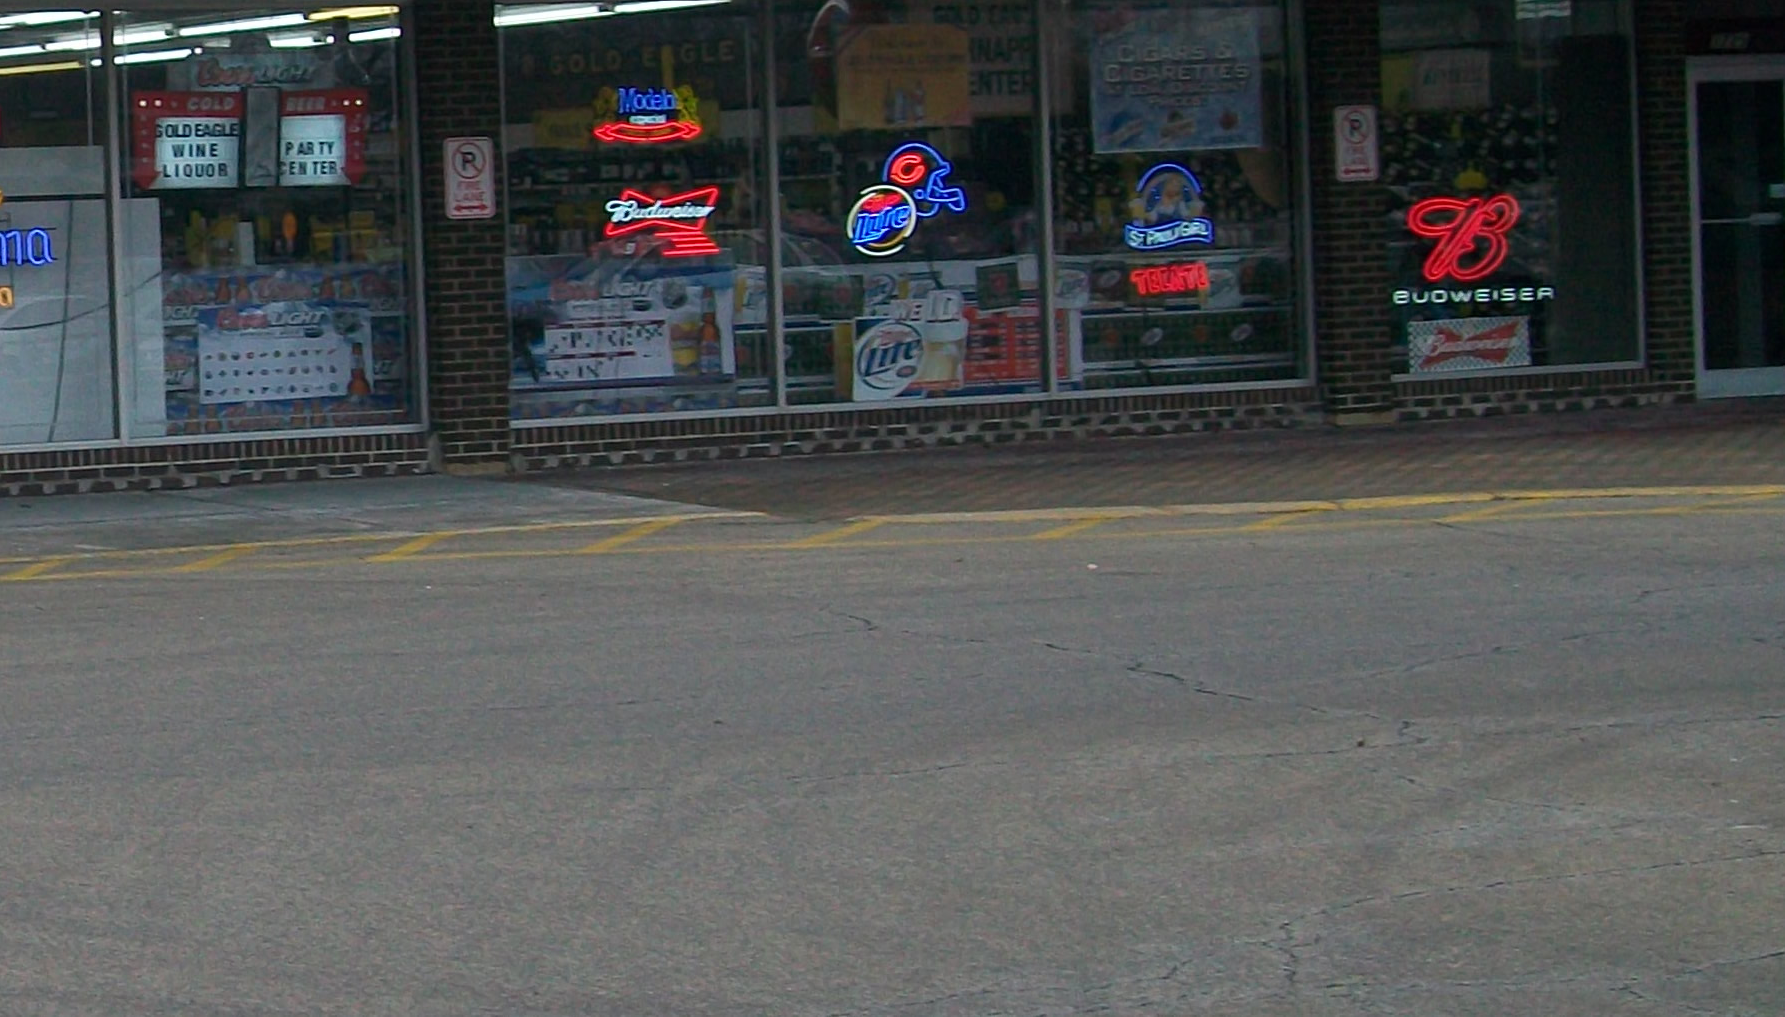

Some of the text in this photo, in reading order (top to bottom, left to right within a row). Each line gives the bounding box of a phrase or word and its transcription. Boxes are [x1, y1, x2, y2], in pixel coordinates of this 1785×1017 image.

[186, 97, 236, 111] COLD
[617, 87, 678, 114] Modelo
[194, 122, 239, 138] EAGLE
[172, 143, 219, 158] WINE
[285, 141, 336, 156] PARTY
[163, 163, 229, 178] LIQUOR
[605, 200, 715, 223] Budweiser
[852, 205, 912, 244] Lite
[1391, 286, 1556, 305] BUDWEISER
